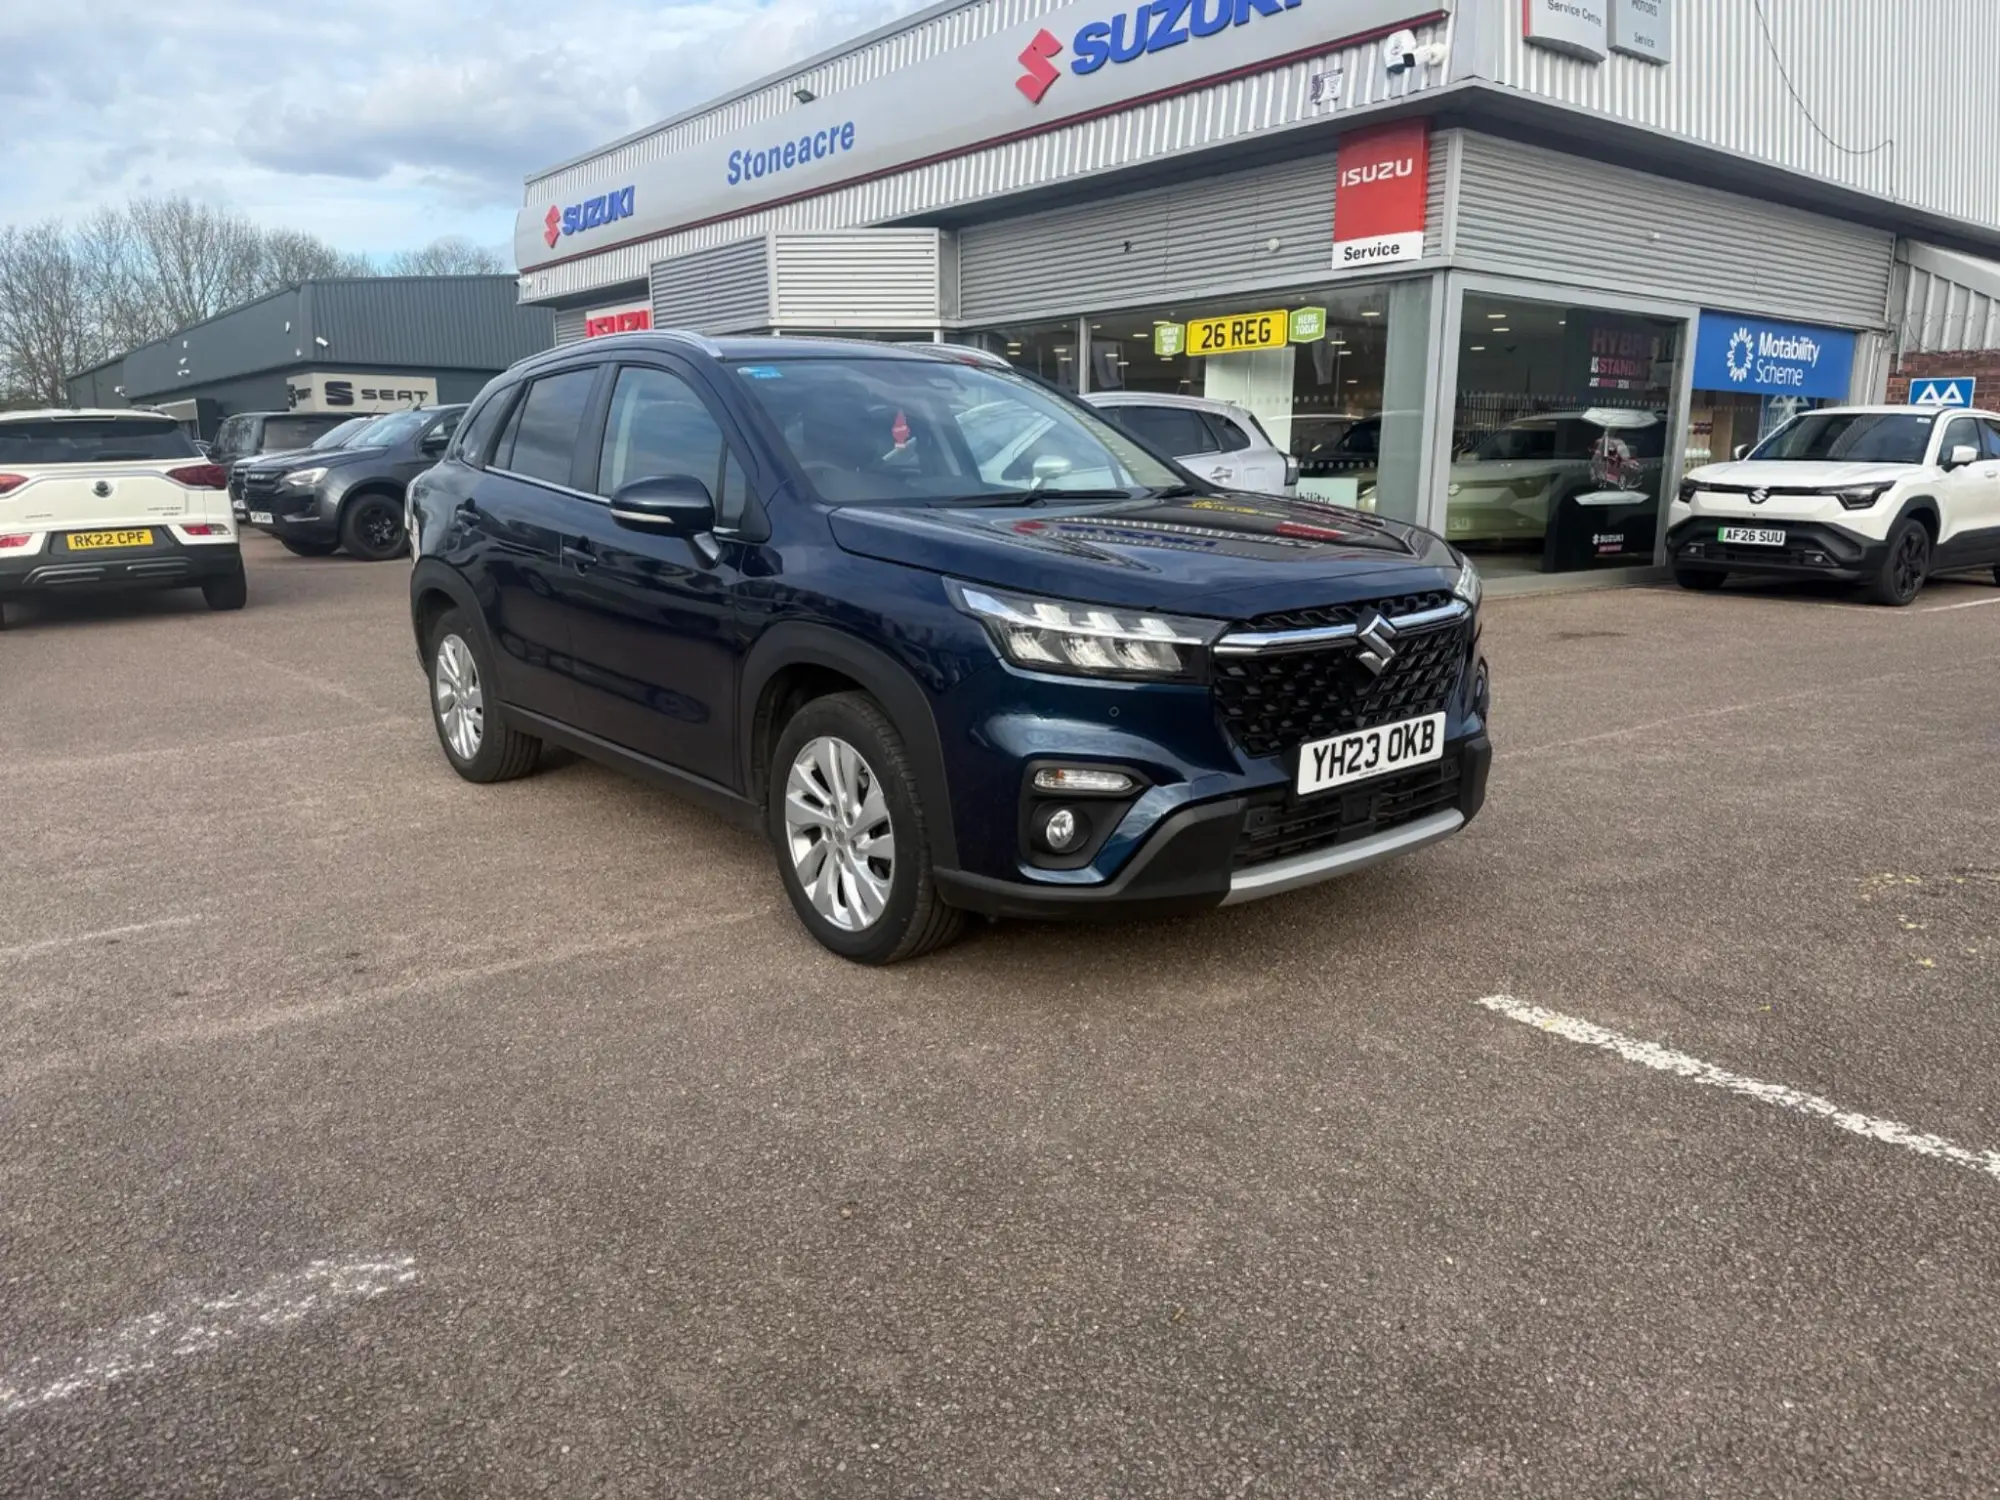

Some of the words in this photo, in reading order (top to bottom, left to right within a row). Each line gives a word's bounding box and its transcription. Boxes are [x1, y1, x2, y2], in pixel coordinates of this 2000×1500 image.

[1547, 0, 1580, 17] Service
[1071, 0, 1304, 75] SUZU
[1633, 32, 1655, 48] Service
[727, 121, 855, 186] Stoneacre
[1341, 158, 1413, 188] ISUZU
[562, 185, 635, 236] SUZUKI
[1343, 242, 1400, 261] Service
[1201, 322, 1226, 349] 26
[1231, 317, 1271, 346] REG
[1758, 331, 1820, 368] Motability
[1755, 358, 1804, 386] Scheme
[361, 389, 428, 402] SEAT
[74, 533, 114, 547] RK22
[117, 531, 145, 544] CPF
[1726, 530, 1756, 541] AF26
[1759, 531, 1783, 543] SUU
[1313, 732, 1381, 782] YH23
[1387, 719, 1435, 762] OKB
